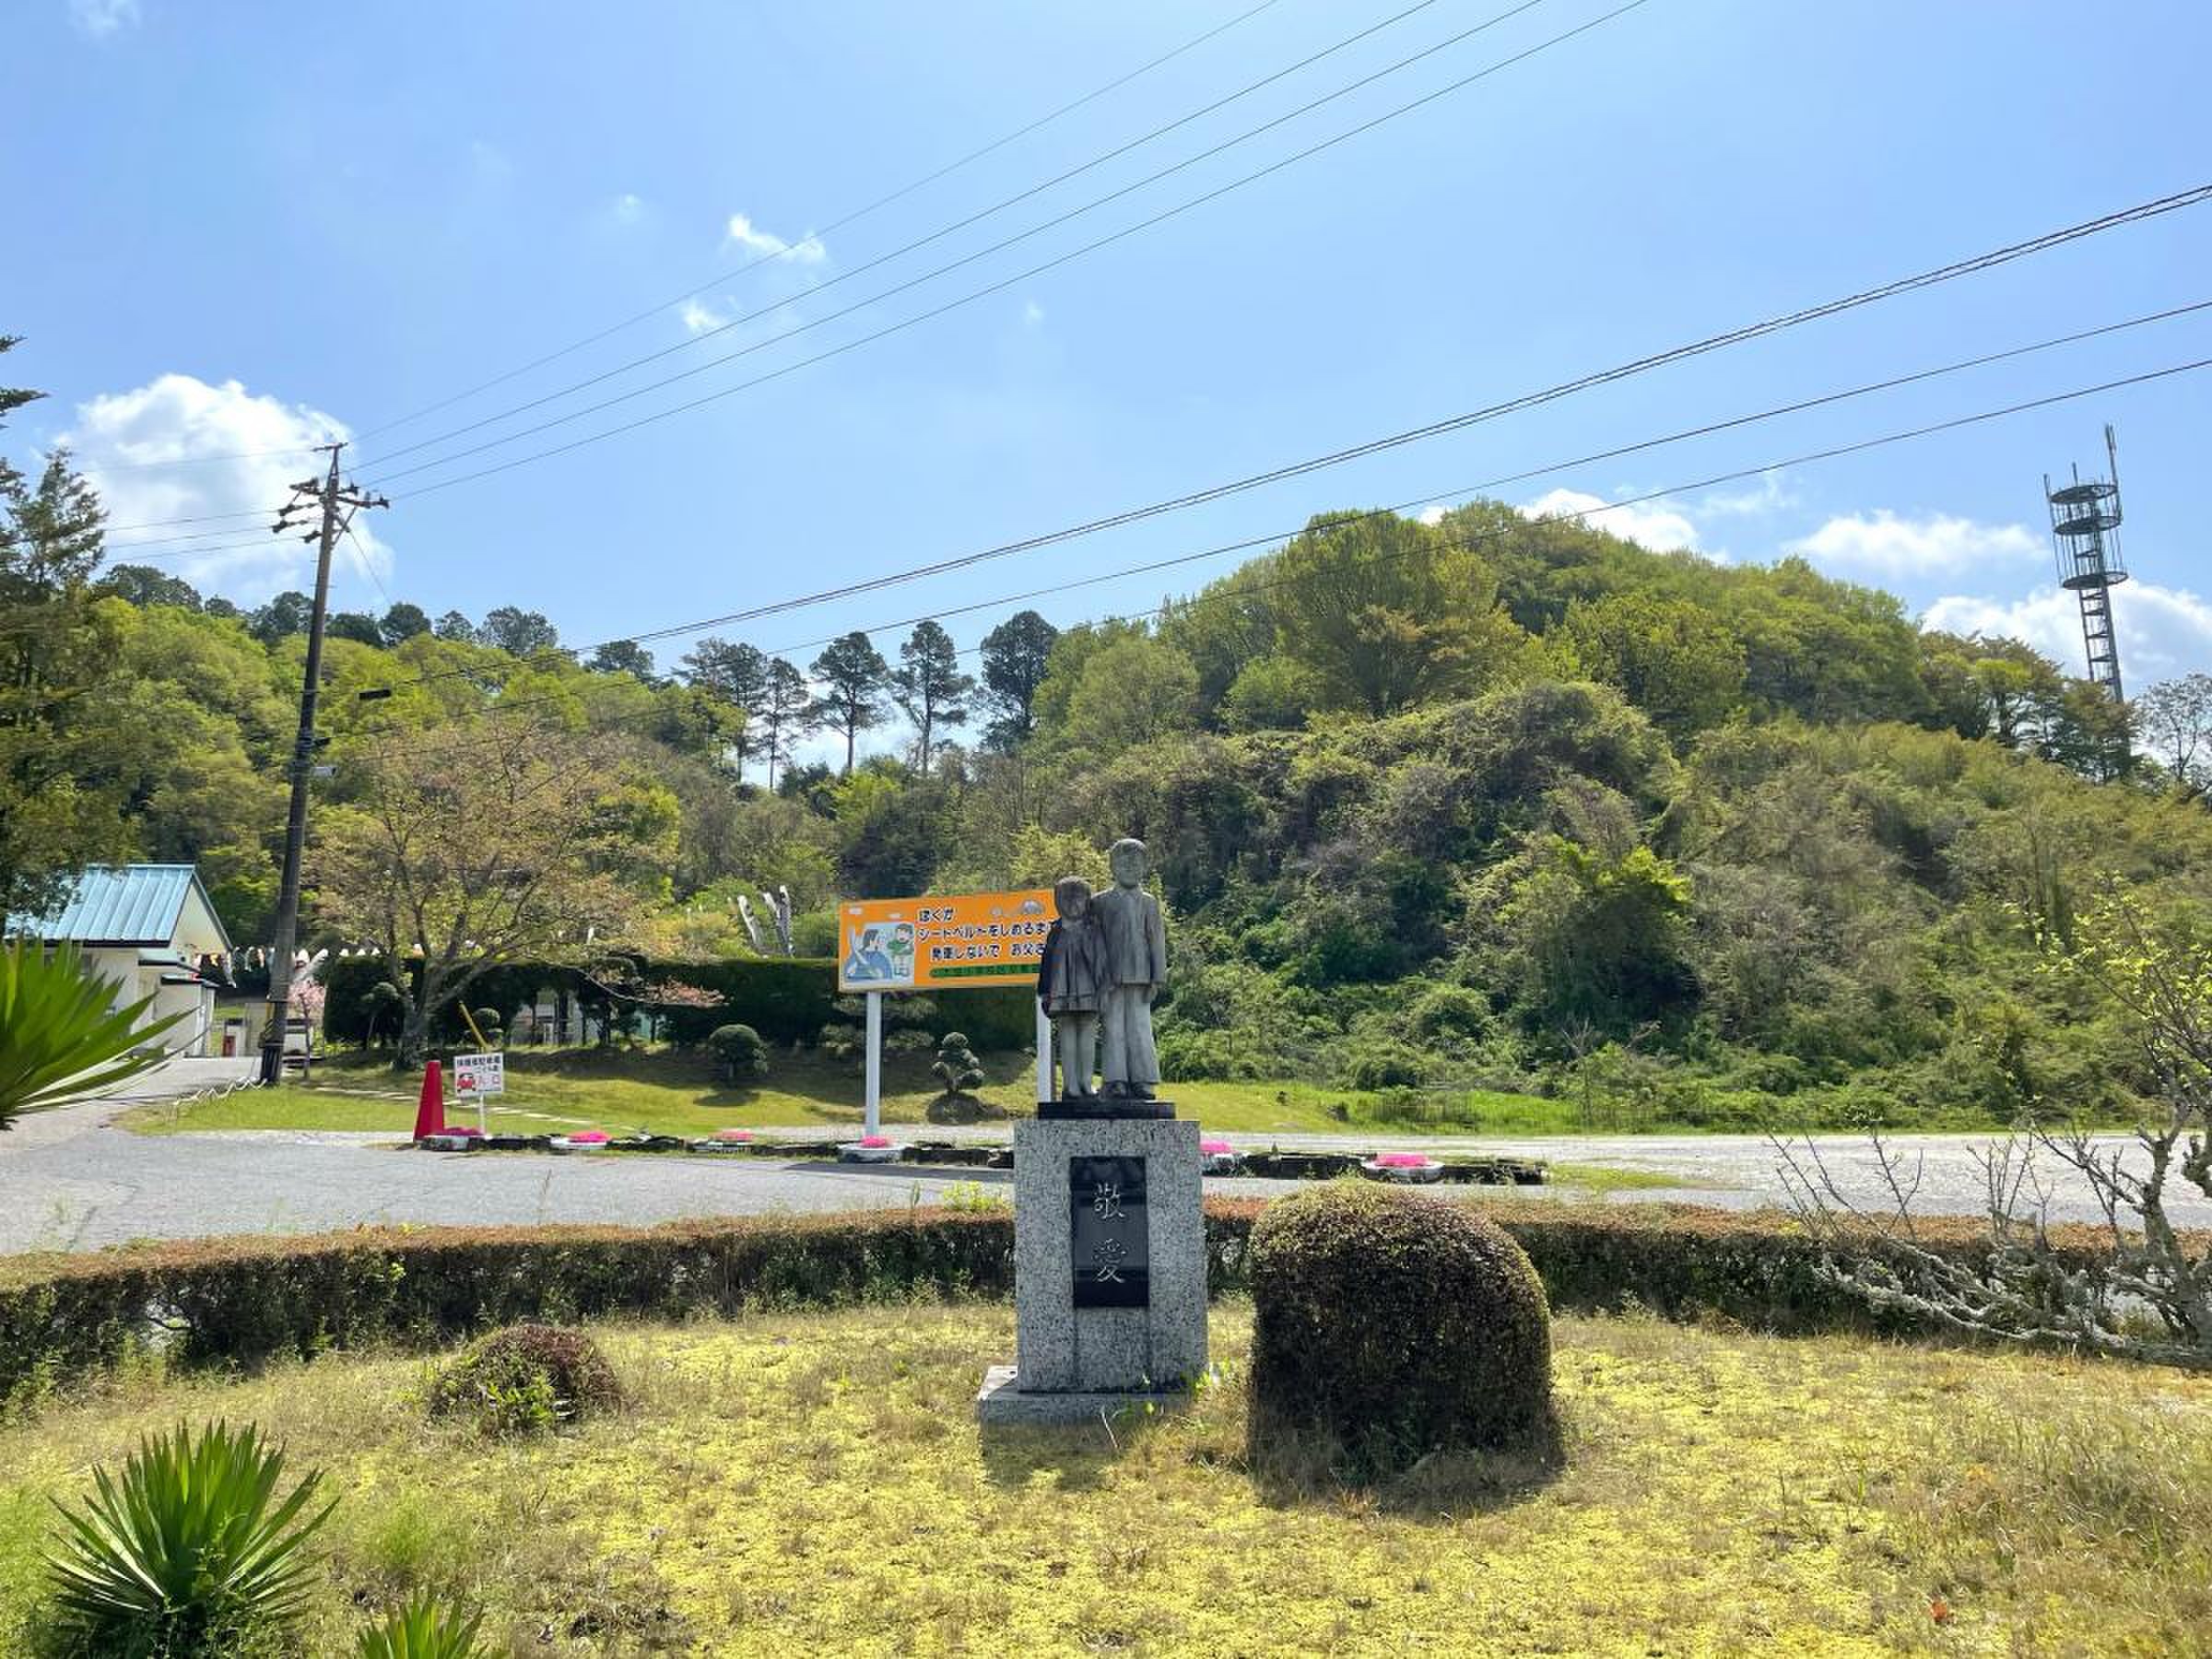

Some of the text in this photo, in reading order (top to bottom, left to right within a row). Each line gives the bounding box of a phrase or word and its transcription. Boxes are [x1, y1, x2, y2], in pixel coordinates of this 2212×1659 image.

[918, 907, 954, 922] ぼくが
[918, 922, 1051, 940] シートベルトをしめるま
[1094, 1182, 1126, 1283] 敬愛
